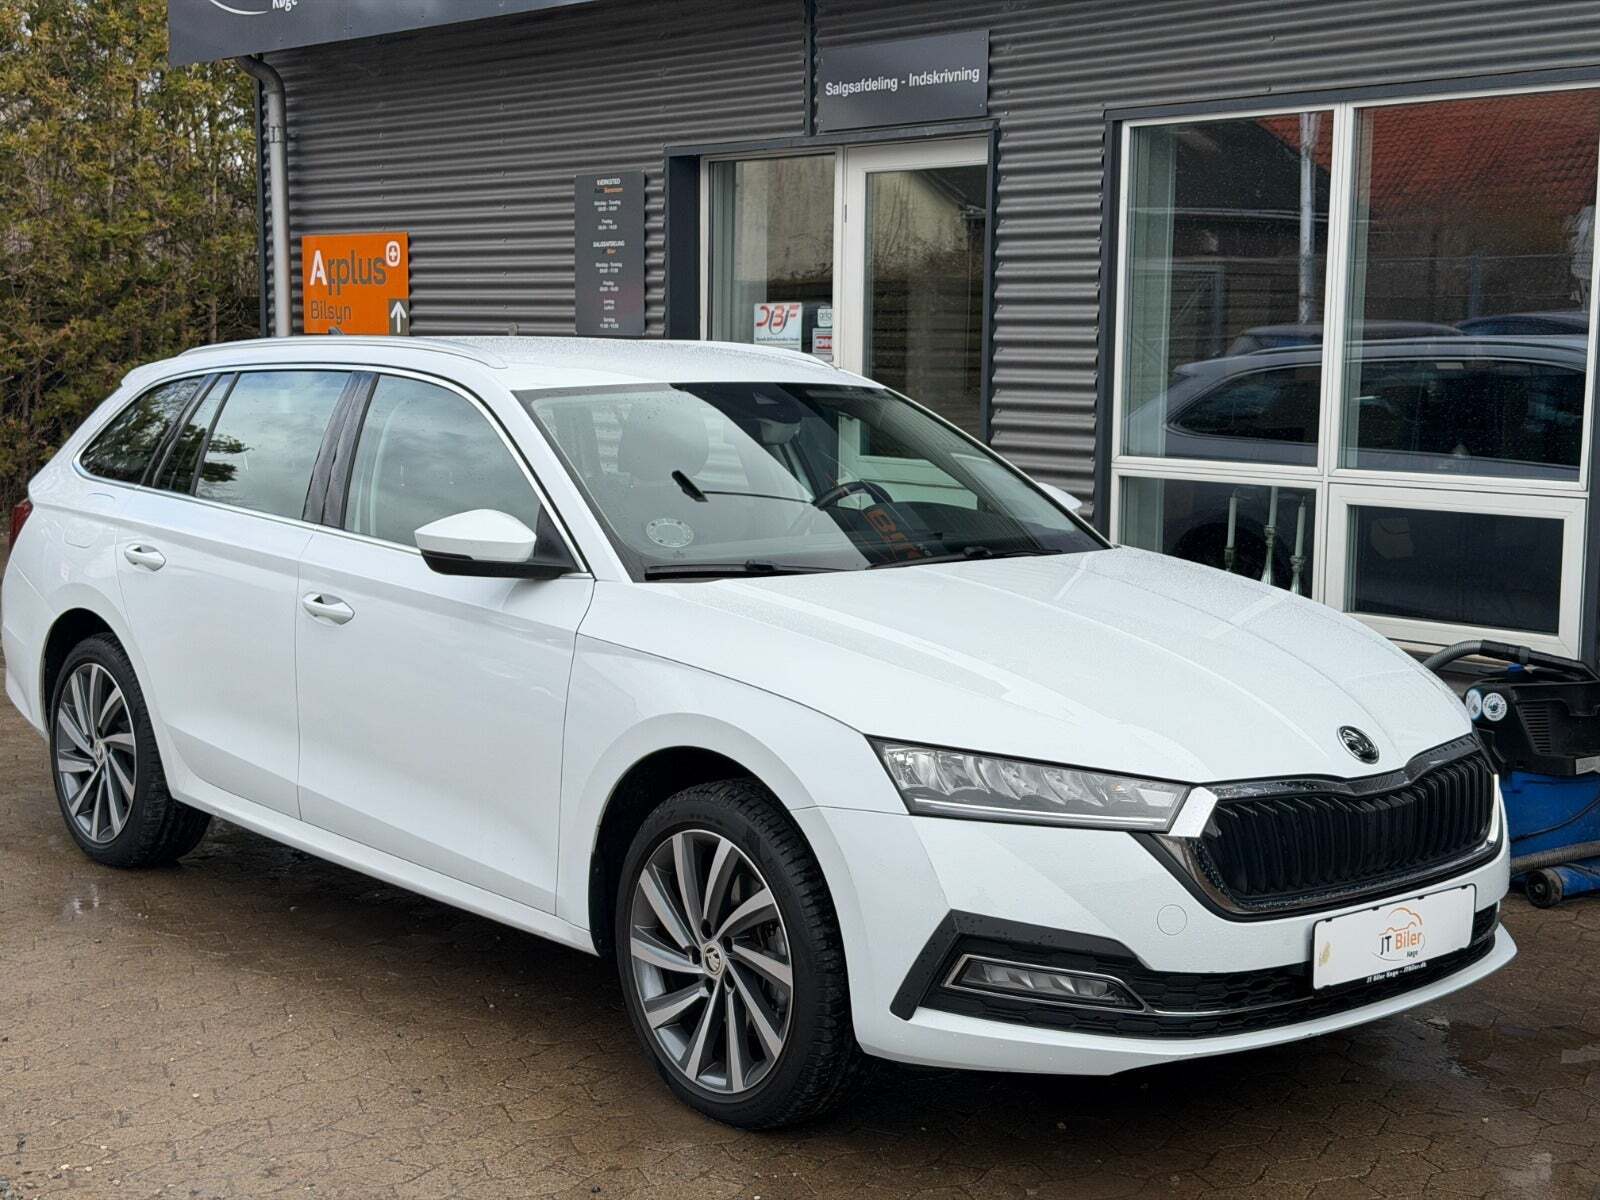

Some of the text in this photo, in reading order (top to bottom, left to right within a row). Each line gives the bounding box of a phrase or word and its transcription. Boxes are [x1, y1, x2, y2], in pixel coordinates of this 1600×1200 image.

[825, 76, 898, 97] Salgsafdeling
[908, 66, 980, 87] Indskrivning
[311, 300, 352, 325] Bilsyn
[1380, 931, 1422, 955] JT Biler
